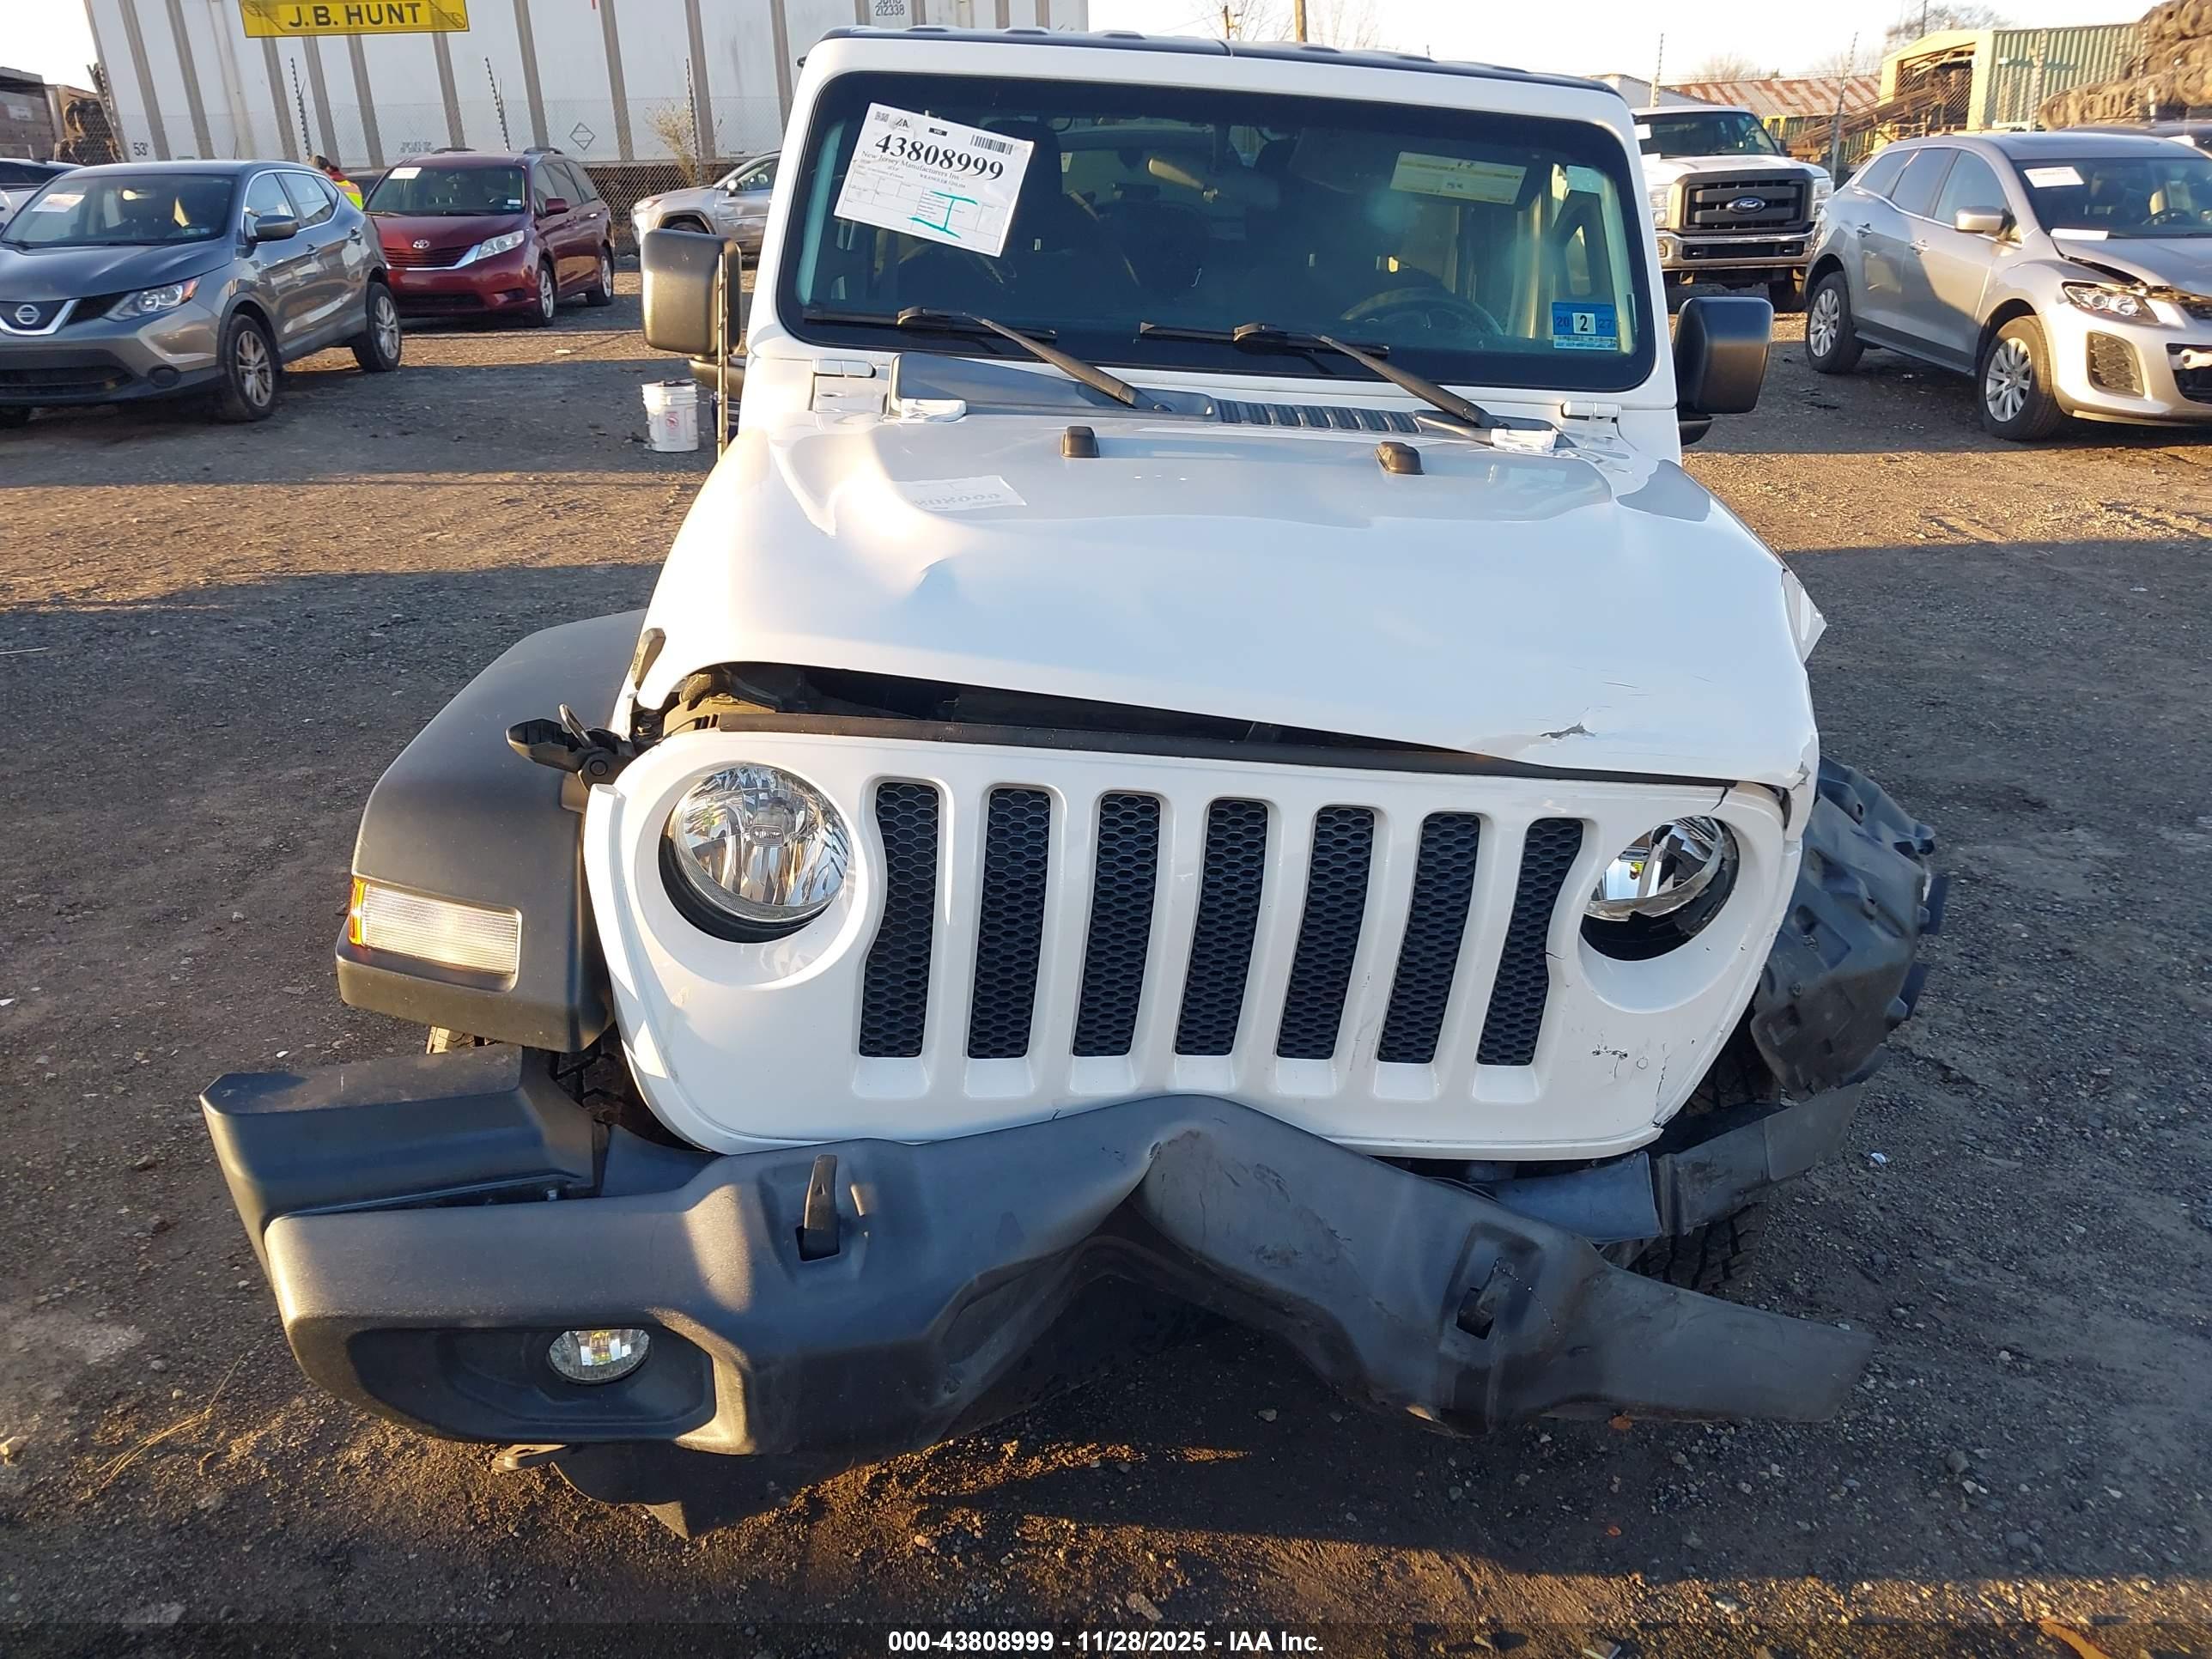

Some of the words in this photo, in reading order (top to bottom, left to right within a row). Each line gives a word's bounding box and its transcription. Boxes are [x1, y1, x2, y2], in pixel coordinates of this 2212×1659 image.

[289, 5, 338, 27] J.B.
[344, 3, 421, 26] HUNT
[875, 4, 904, 16] 212338
[861, 150, 877, 159] New
[878, 155, 899, 166] Jersey
[902, 160, 948, 177] Manufacturers
[874, 134, 1004, 181] 43808999
[1580, 315, 1588, 331] 2
